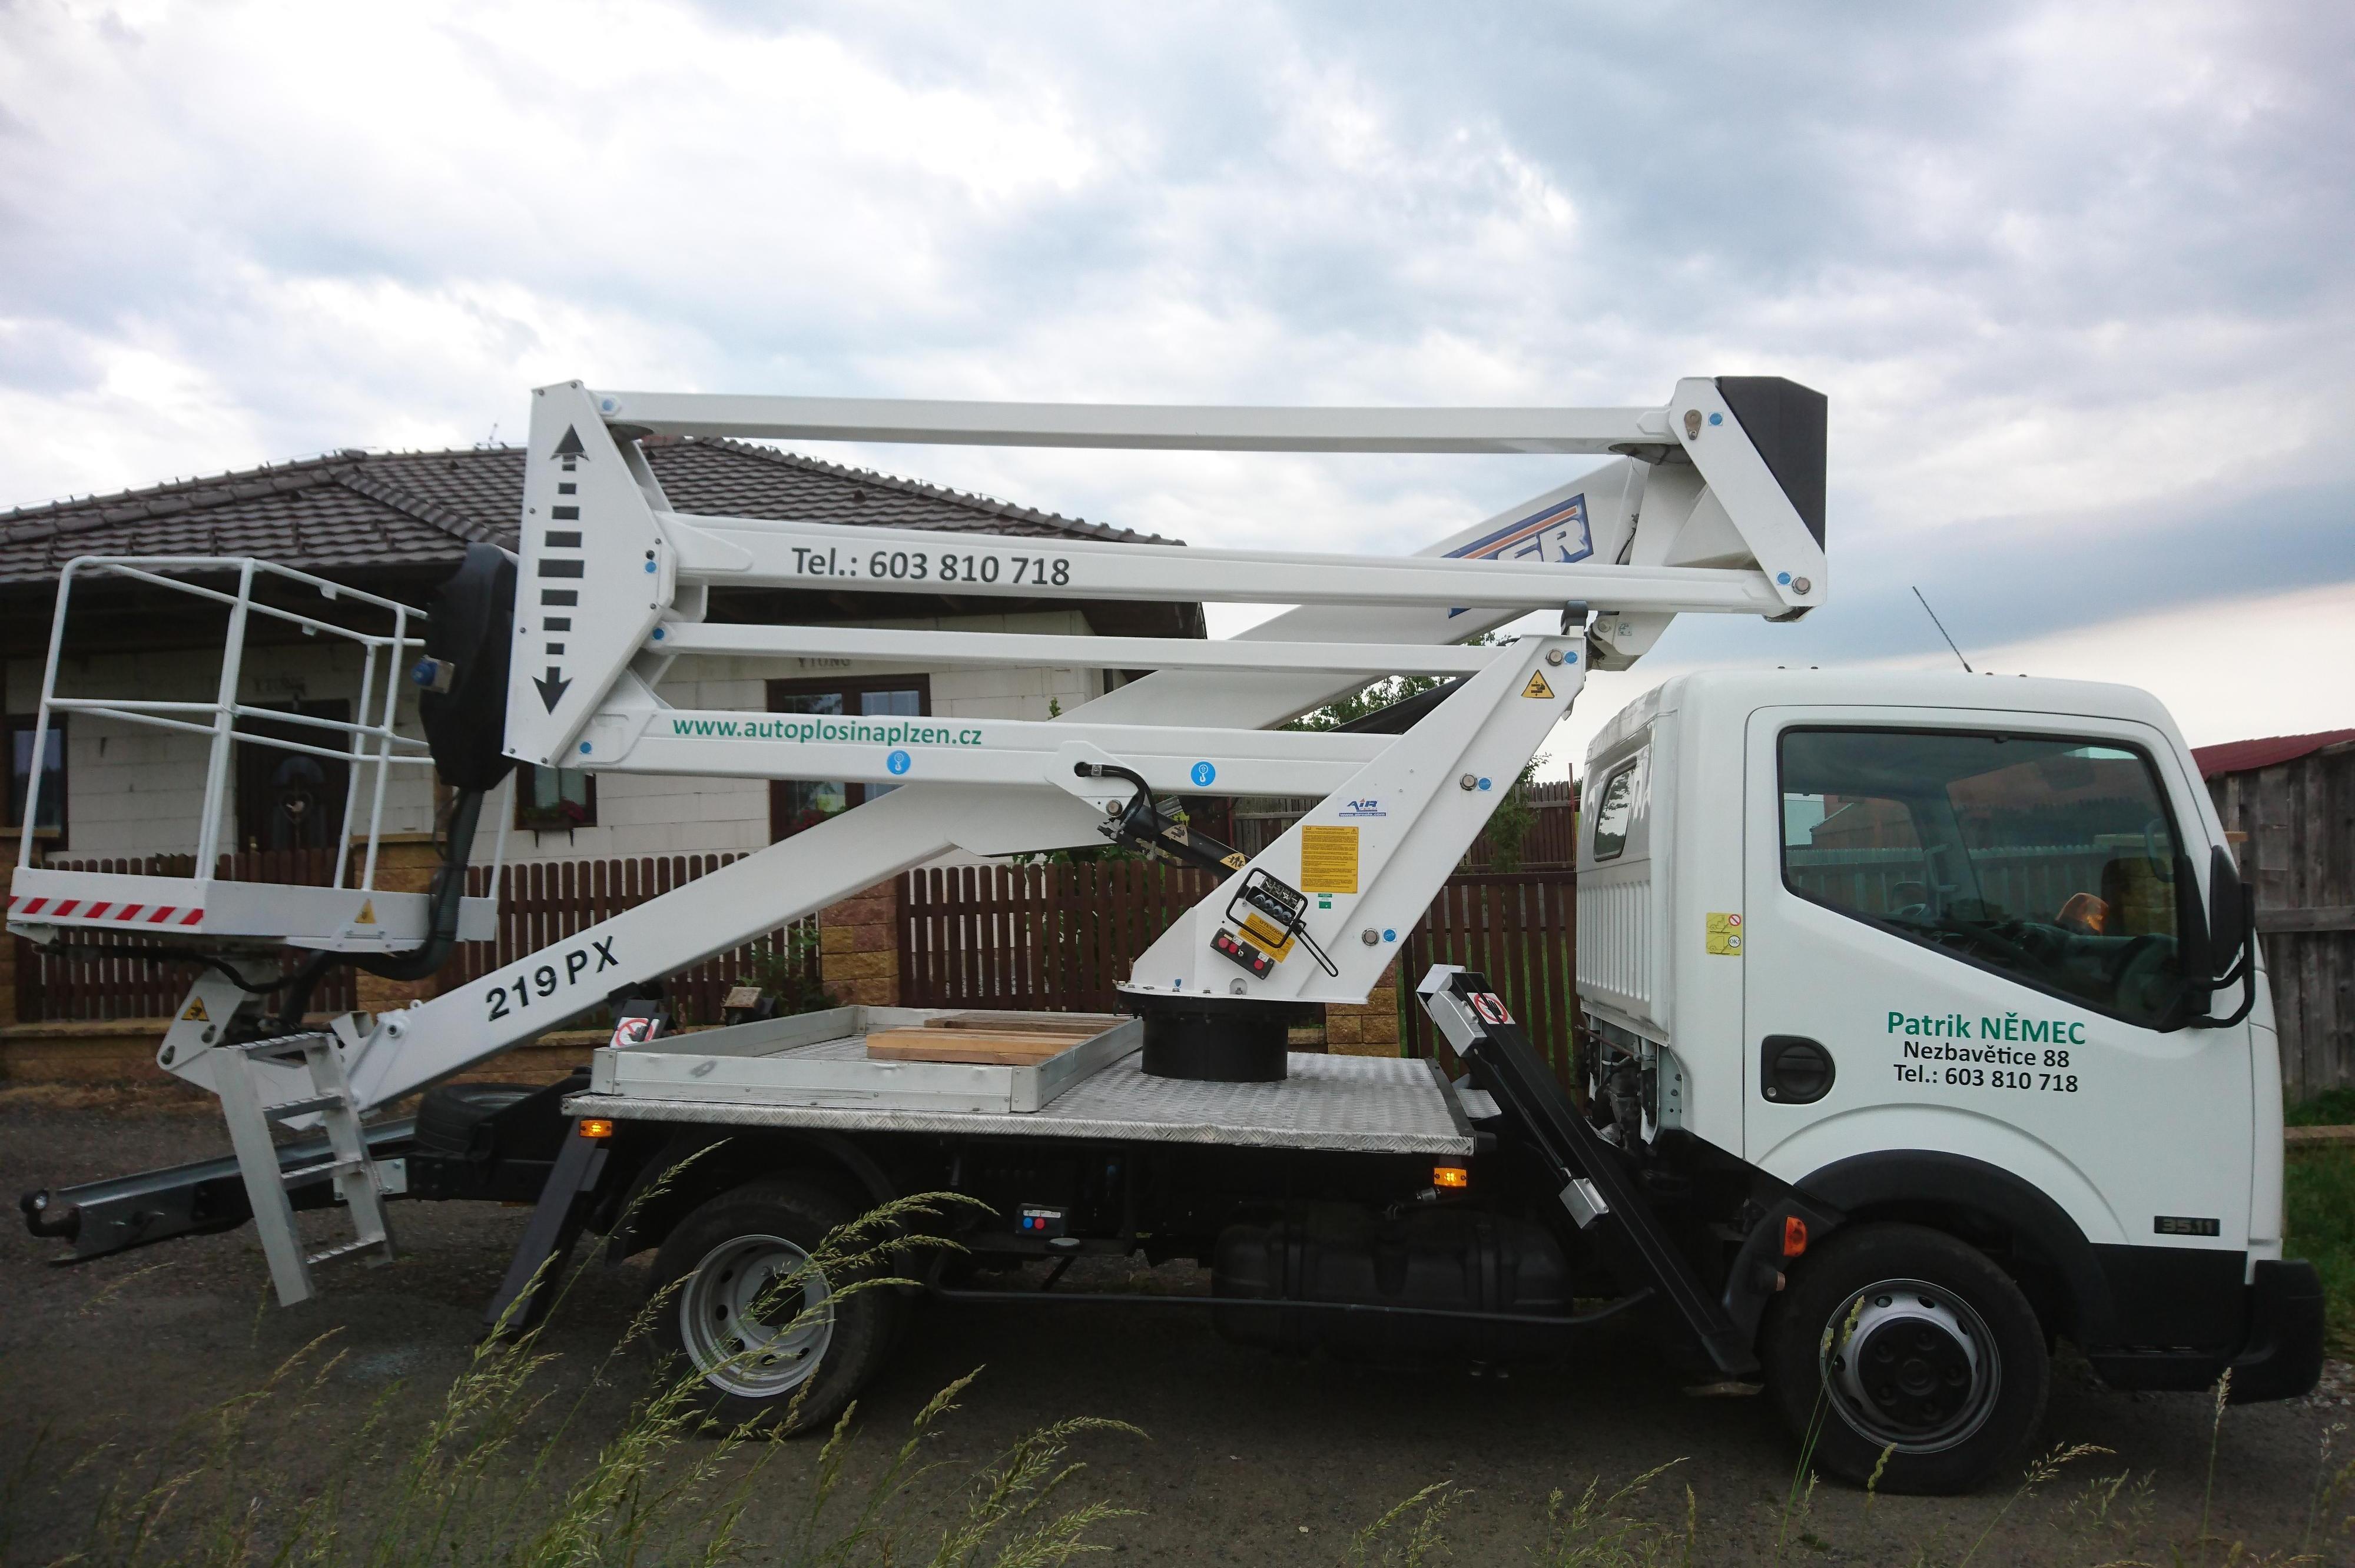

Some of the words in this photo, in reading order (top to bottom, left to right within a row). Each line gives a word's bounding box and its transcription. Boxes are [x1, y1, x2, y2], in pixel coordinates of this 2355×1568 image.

[791, 547, 857, 577] Tel.:
[869, 550, 928, 579] 603
[939, 553, 1000, 583] 810
[1011, 556, 1070, 586] 718
[672, 717, 982, 746] www.autoplosinaplzen.cz
[1888, 1011, 1971, 1039] Patrik
[1981, 1012, 2086, 1045] NĚMEC
[1903, 1041, 2036, 1065] Nezbavětice
[2043, 1049, 2069, 1068] 88
[1893, 1064, 1938, 1084] Tel.:
[1945, 1067, 1984, 1087] 603
[1992, 1070, 2031, 1089] 810
[2039, 1073, 2078, 1092] 718
[2162, 1218, 2213, 1234] 35.11
